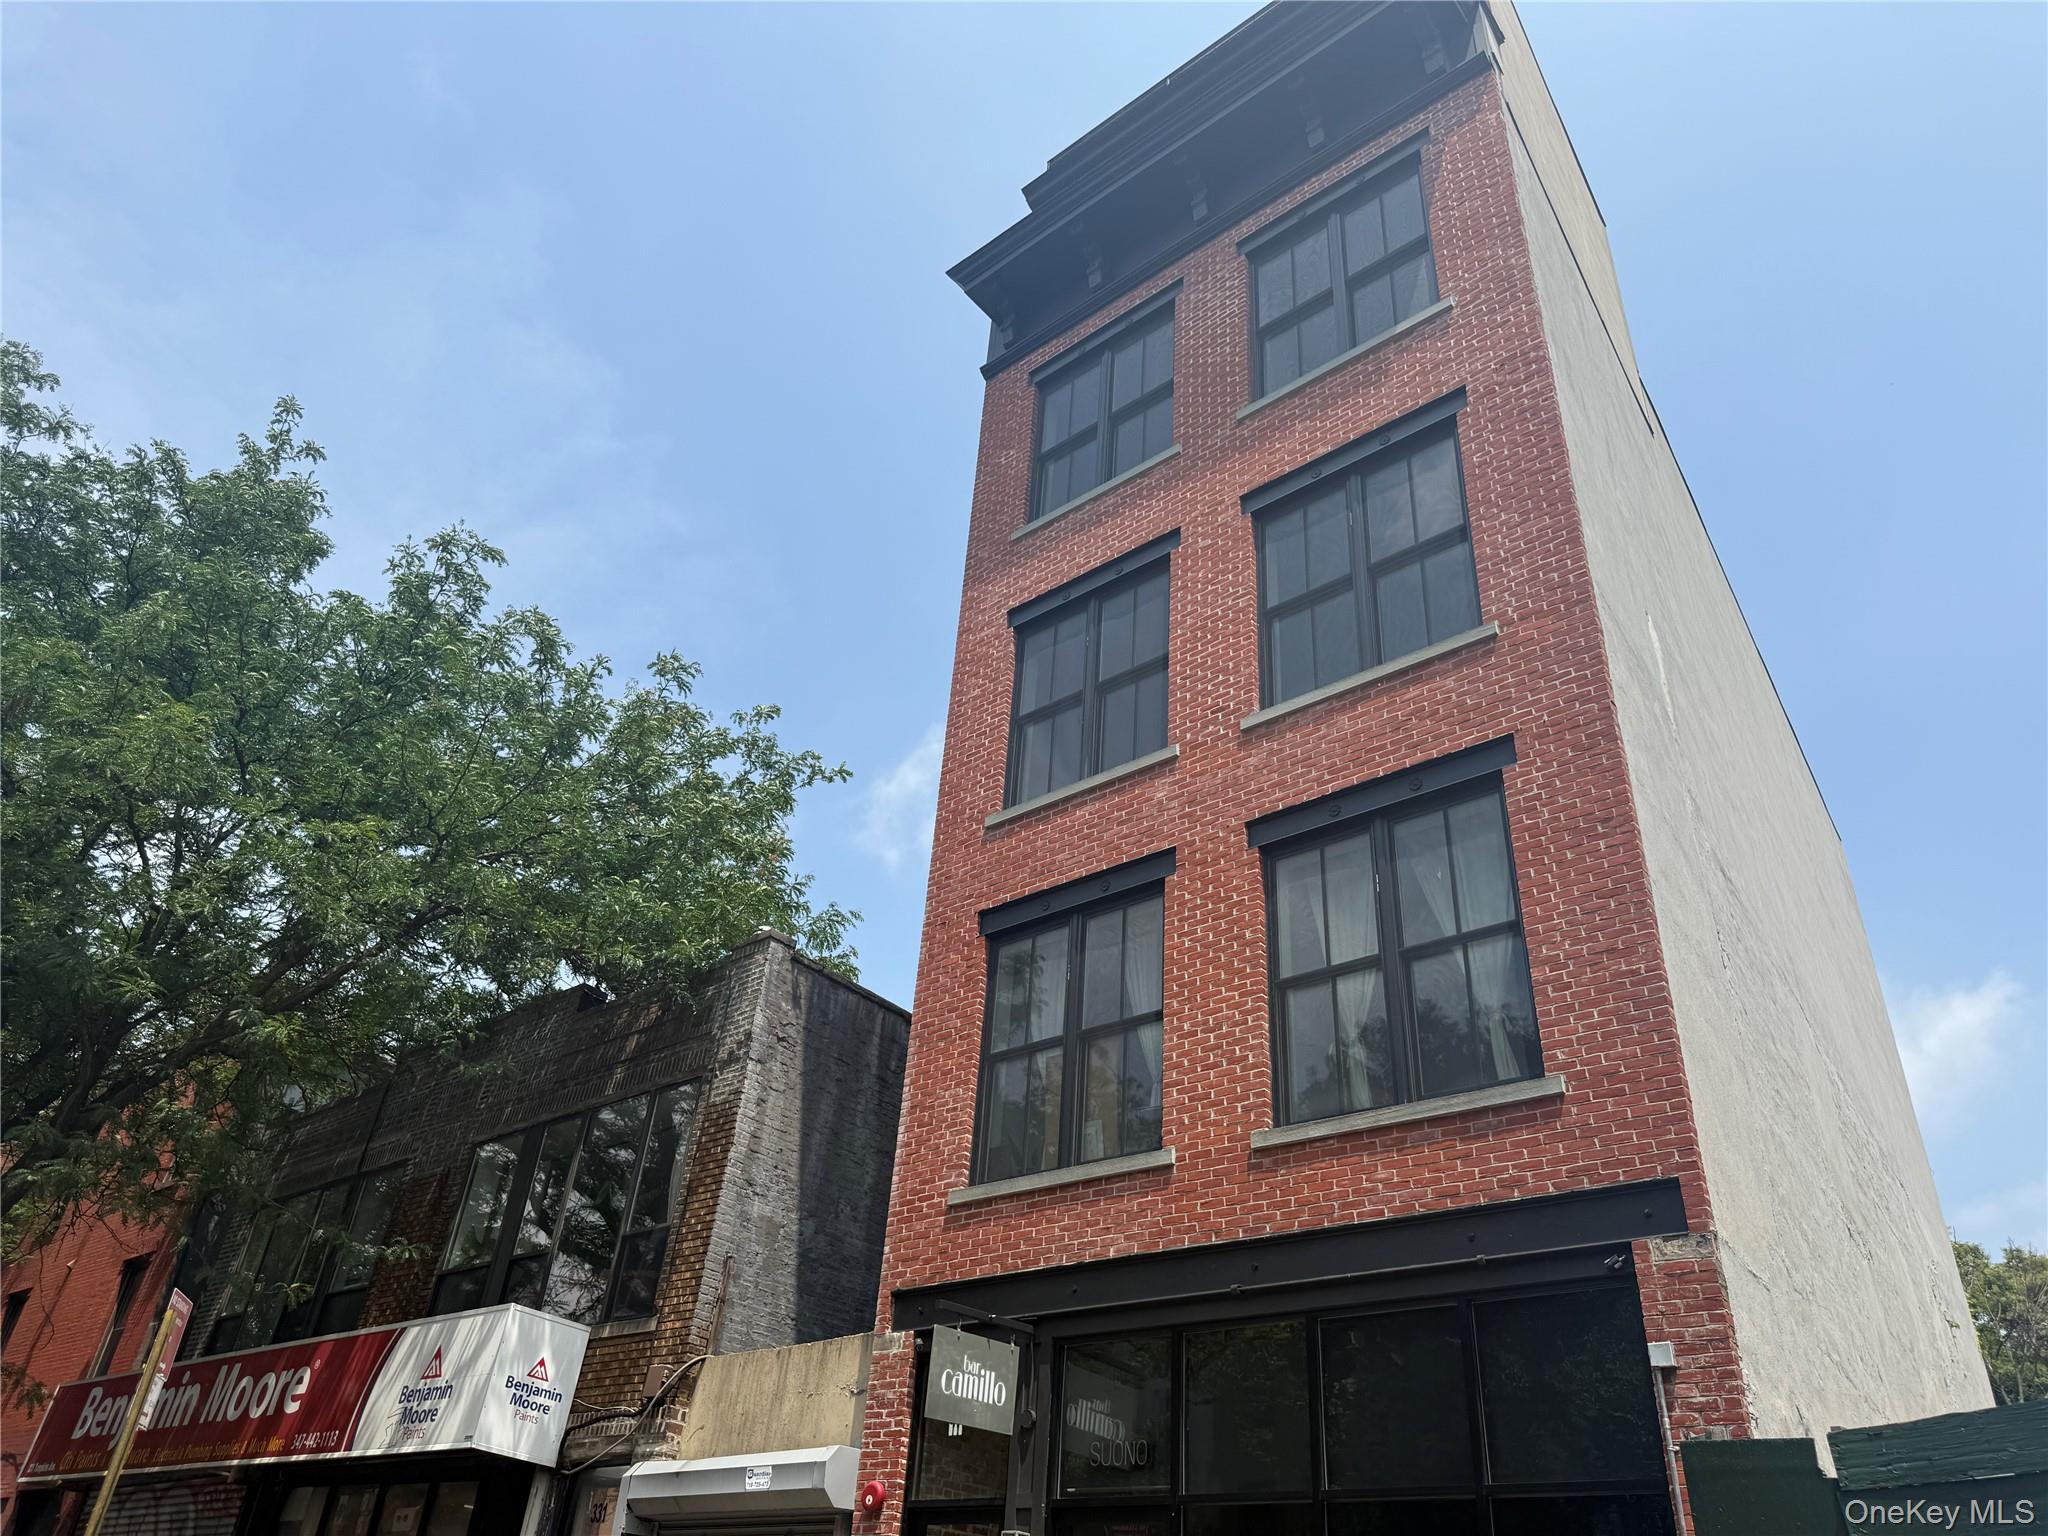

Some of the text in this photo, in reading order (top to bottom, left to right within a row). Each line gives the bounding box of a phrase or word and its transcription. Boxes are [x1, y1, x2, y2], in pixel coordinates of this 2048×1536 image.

[963, 1354, 981, 1375] bar
[398, 1379, 453, 1407] Benjamin
[504, 1375, 563, 1403] Benjamin
[941, 1368, 1006, 1407] camillo
[71, 1362, 311, 1451] Benjmin Moore
[509, 1392, 551, 1415] Moore
[399, 1405, 439, 1425] Moore
[514, 1408, 540, 1425] Paints
[291, 1430, 340, 1450] 347-442-1113
[401, 1424, 426, 1441] Paints
[1090, 1440, 1148, 1466] SUONO
[590, 1503, 608, 1524] 331
